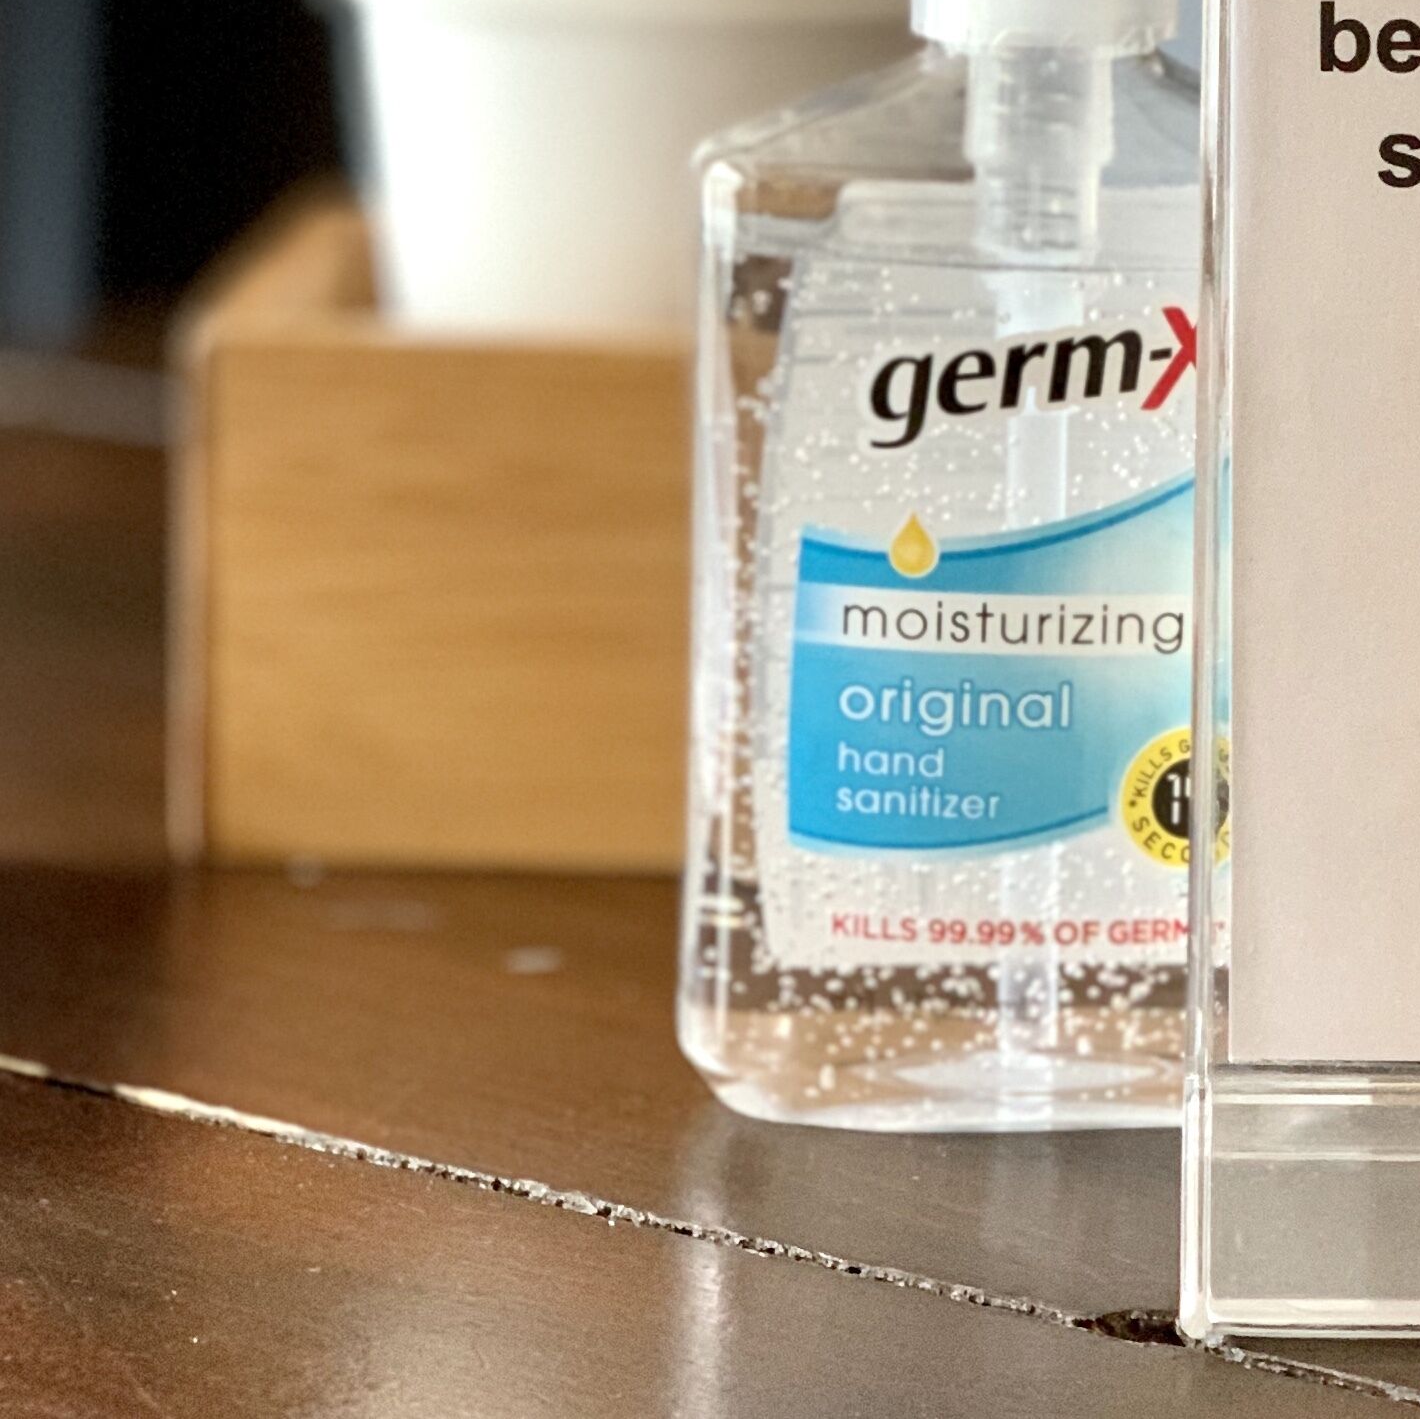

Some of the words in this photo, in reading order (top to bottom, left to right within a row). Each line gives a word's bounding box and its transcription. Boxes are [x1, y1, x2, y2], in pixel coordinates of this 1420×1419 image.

[843, 600, 1185, 655] moisturizing
[838, 679, 1073, 737] original
[837, 741, 945, 778] hand
[836, 786, 1001, 820] sanitizer
[831, 913, 918, 942] KILLS
[927, 918, 1046, 946] 99.99%
[1053, 920, 1100, 946] OF
